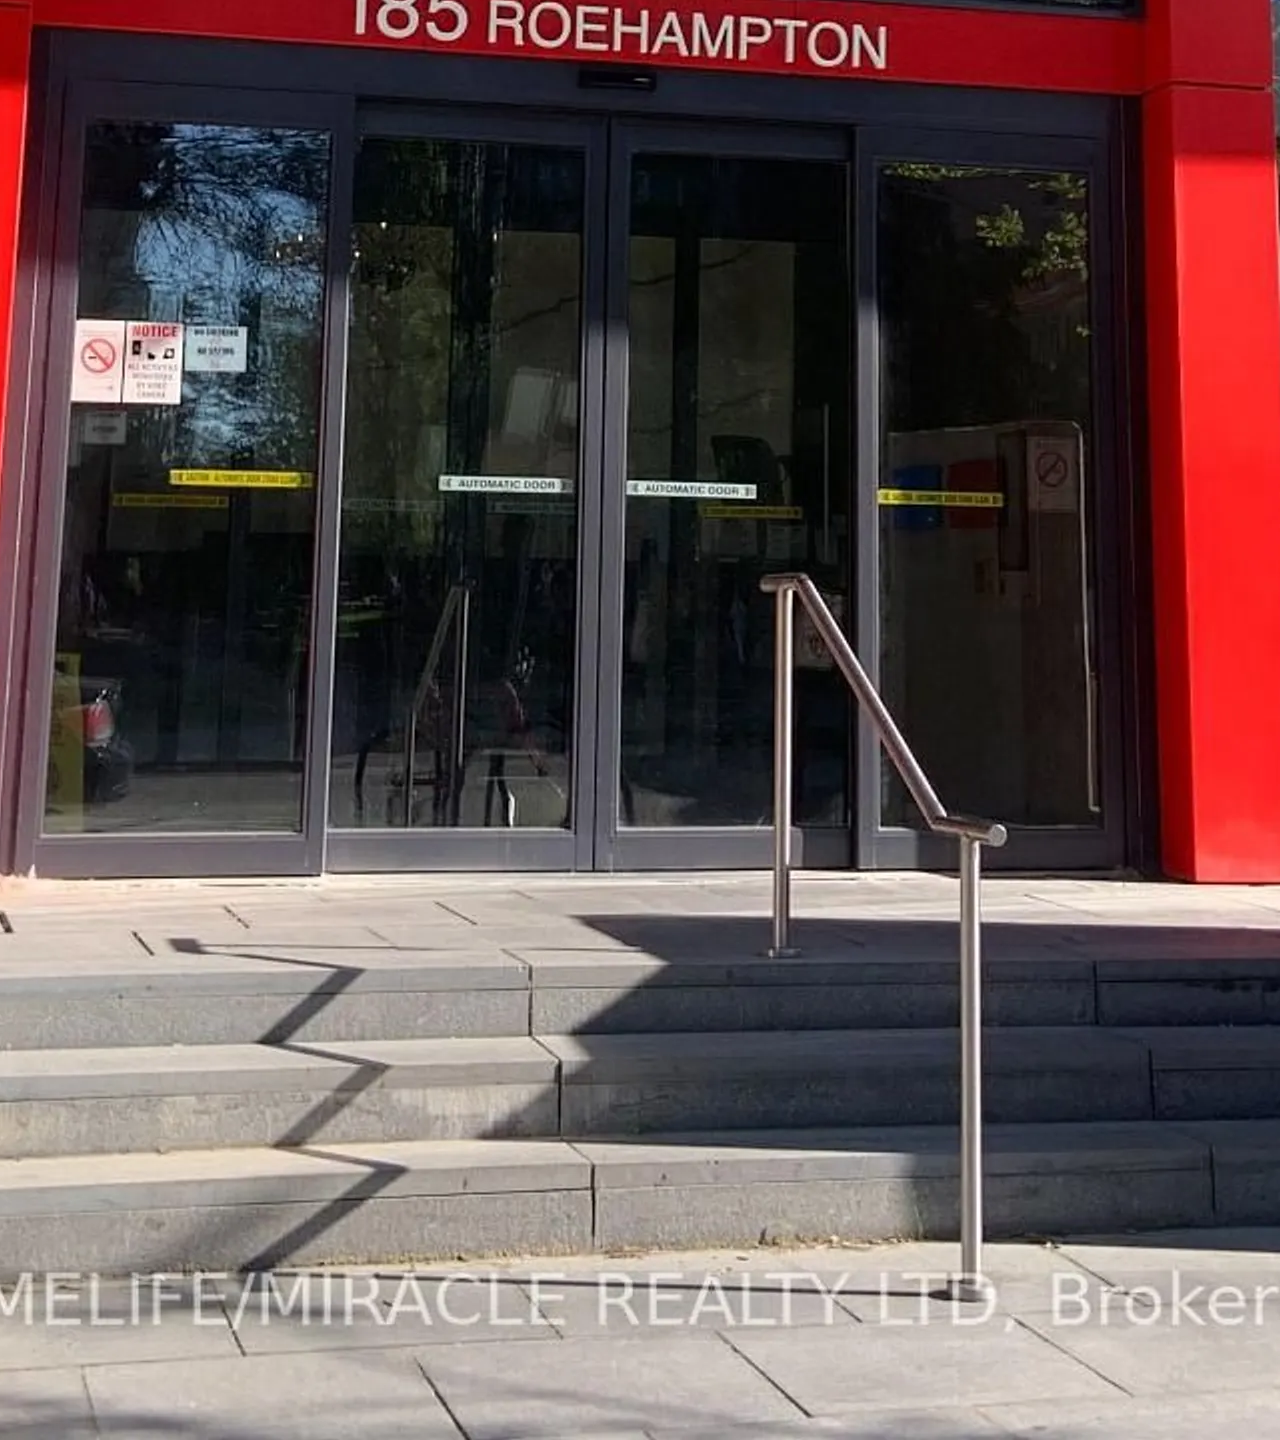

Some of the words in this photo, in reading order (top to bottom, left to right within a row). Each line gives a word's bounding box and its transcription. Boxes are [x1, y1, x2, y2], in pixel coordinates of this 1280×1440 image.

[131, 325, 179, 338] NOTICE
[458, 479, 521, 490] AUTOMATIC
[523, 480, 556, 491] DOOR
[645, 484, 706, 495] AUTOMATIC
[707, 486, 740, 496] DOOR
